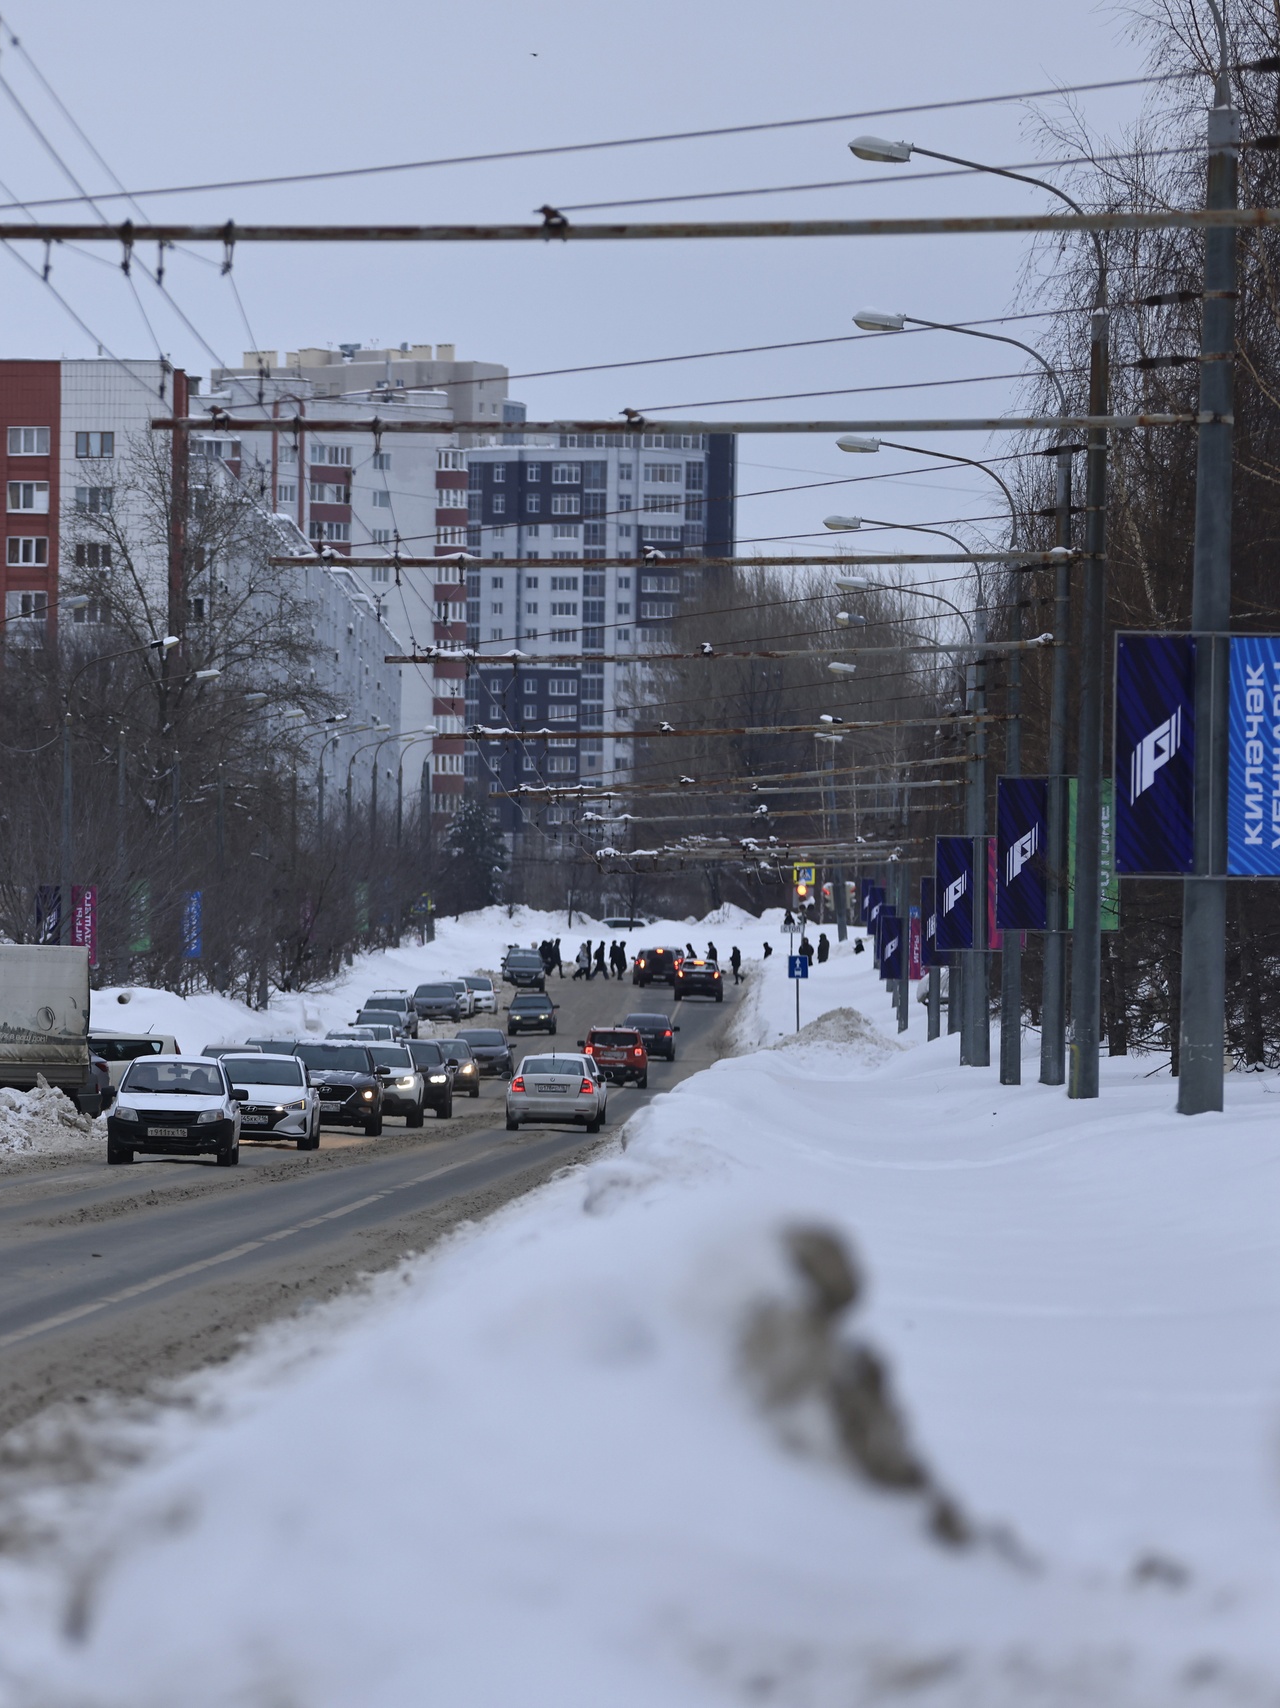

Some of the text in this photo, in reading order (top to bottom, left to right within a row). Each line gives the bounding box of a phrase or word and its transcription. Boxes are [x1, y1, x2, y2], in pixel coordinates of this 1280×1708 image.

[1244, 662, 1265, 845] КИЛӘЧӘК
[75, 907, 83, 943] ИГРЫ
[84, 891, 92, 959] УДУЩЕГО
